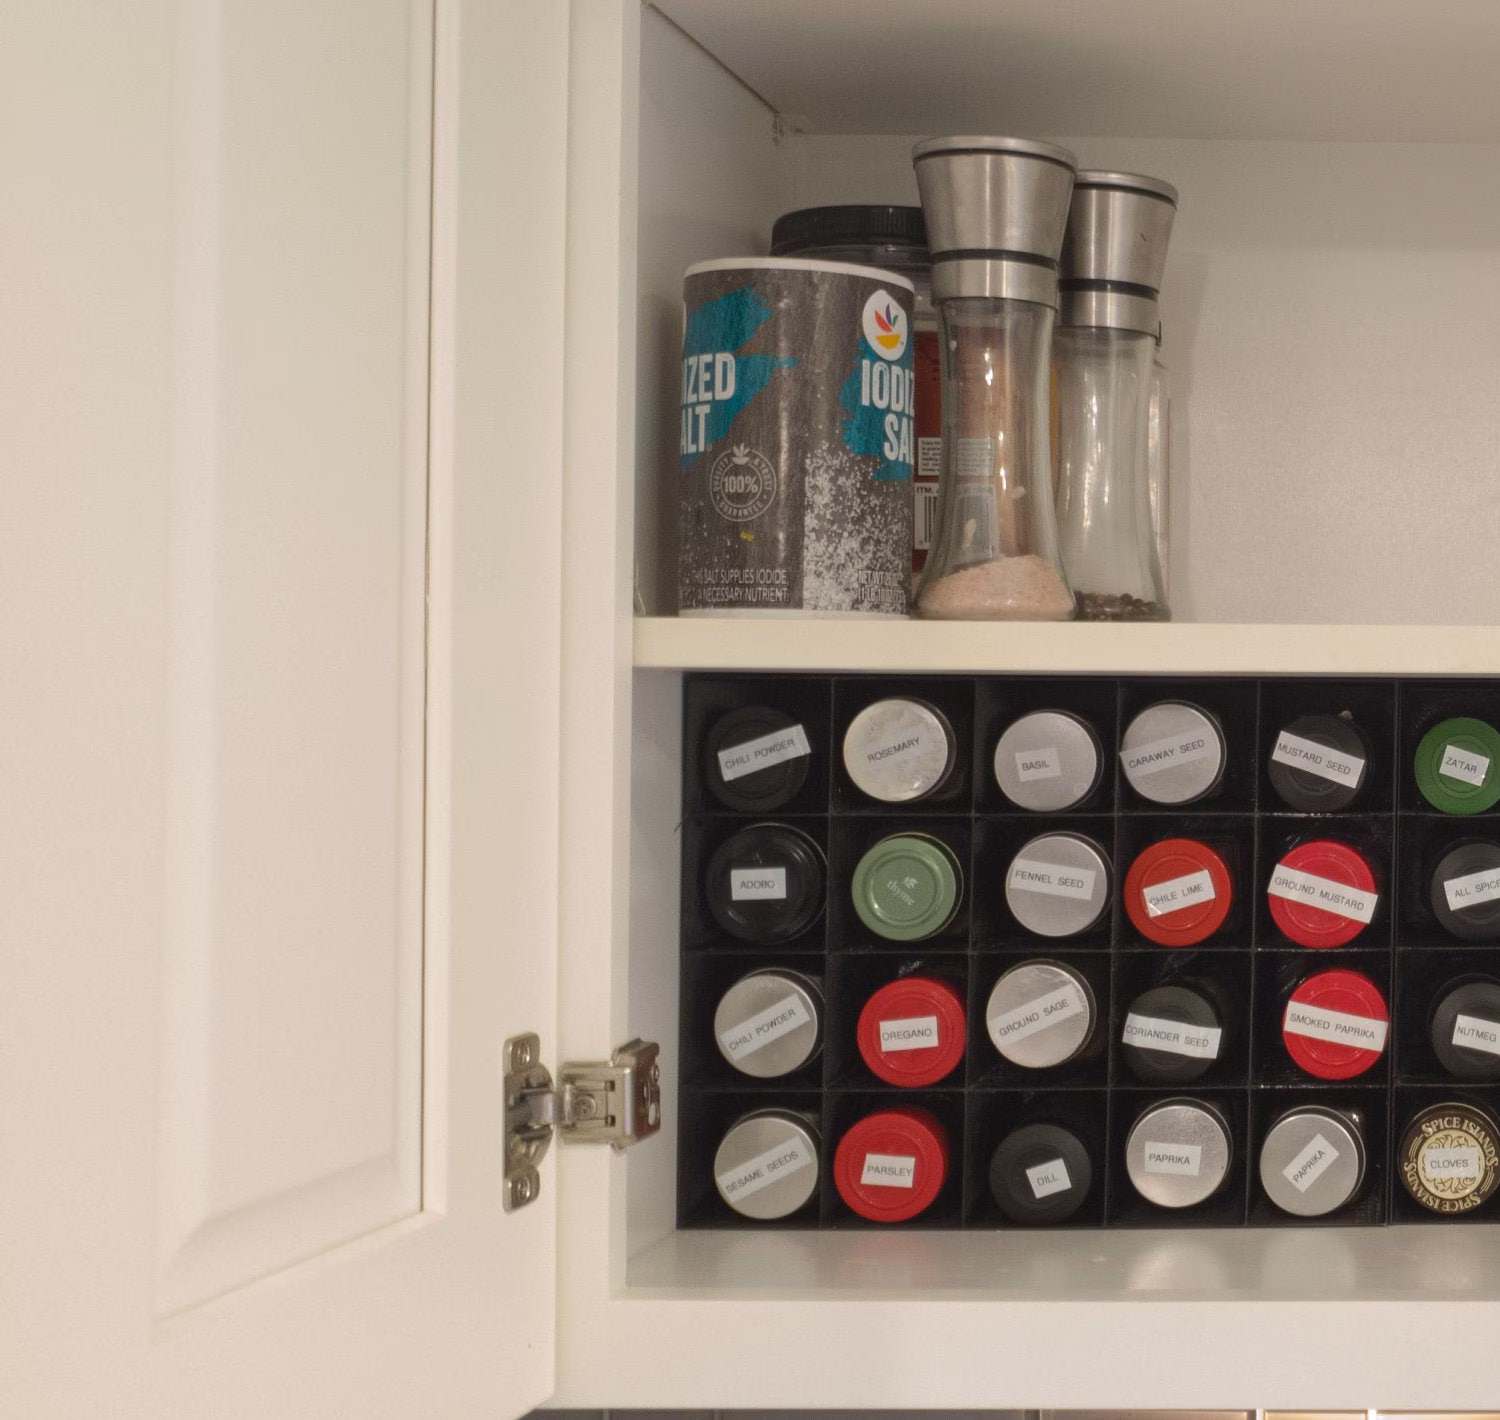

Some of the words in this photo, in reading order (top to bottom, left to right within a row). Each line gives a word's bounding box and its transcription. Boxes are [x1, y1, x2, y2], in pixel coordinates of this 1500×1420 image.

[723, 476, 758, 493] 100%
[720, 569, 755, 584] SUPPLIES
[756, 569, 789, 586] IODIDE,
[724, 755, 751, 770] CHILI
[754, 738, 796, 759] POWDER
[867, 736, 921, 764] ROSEMARY
[1128, 748, 1175, 769] CARAWAY
[1179, 739, 1206, 754] SEED
[1277, 742, 1322, 765] MUSTARD
[1326, 759, 1351, 775] SEED
[1022, 759, 1050, 772] BASIL
[1445, 756, 1478, 774] ZA'TAR
[740, 880, 775, 889] ADOBO
[1015, 870, 1053, 885] FENNEL
[1058, 877, 1084, 889] SEED
[1149, 891, 1178, 907] CHILE
[1182, 883, 1204, 897] LIME
[1274, 877, 1315, 896] GROUND
[1320, 889, 1364, 911] MUSTARD
[1454, 888, 1471, 898] ALL
[999, 1013, 1040, 1037] GROUND
[1043, 998, 1070, 1017] SAGE
[1289, 1012, 1330, 1030] SMOKED
[1334, 1022, 1376, 1039] PAPRIKA
[728, 1032, 753, 1051] CHILI
[755, 1008, 797, 1036] POWDER
[882, 1028, 932, 1041] OREGANO
[1126, 1024, 1180, 1042] CORIANDER
[1184, 1036, 1209, 1048] SEED
[1456, 1025, 1497, 1043] NUTMEG
[1421, 1117, 1461, 1137] SPICE
[1461, 1119, 1499, 1167] ISLANDS
[1149, 1153, 1191, 1165] PAPRIKA
[1292, 1148, 1326, 1183] PAPRIKA
[1430, 1159, 1469, 1169] CLOVES
[725, 1168, 764, 1195] SESAME
[766, 1150, 799, 1173] SEEDS
[867, 1165, 913, 1177] PARSLEY
[1037, 1173, 1058, 1187] DILL
[1403, 1161, 1440, 1209] ISLANDS
[1441, 1191, 1481, 1212] SPICE
